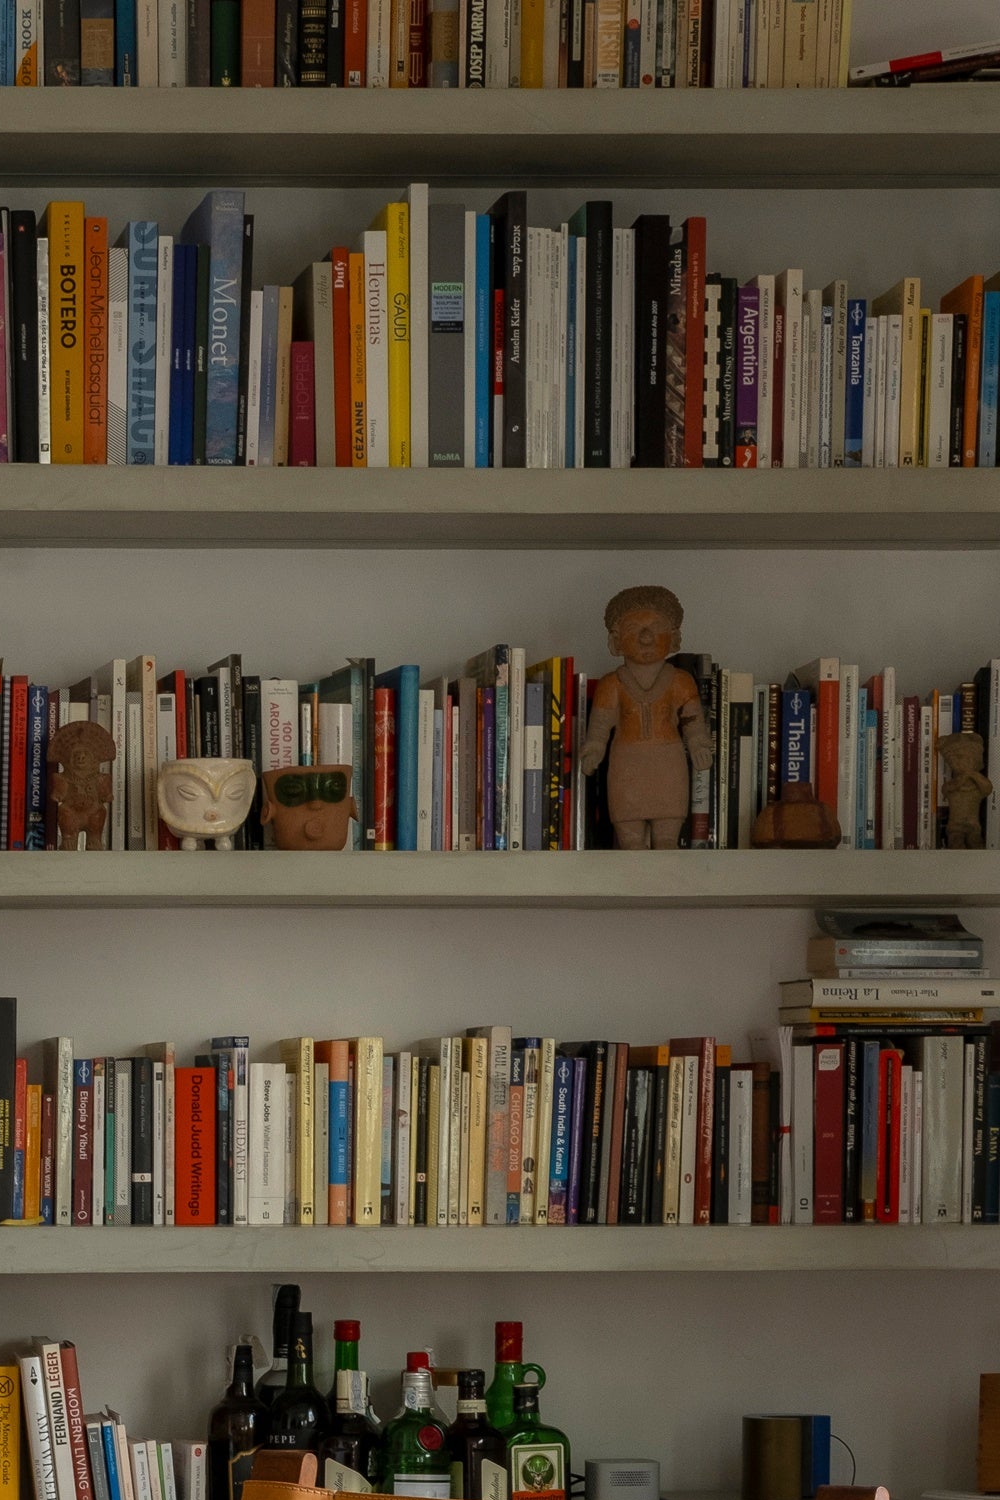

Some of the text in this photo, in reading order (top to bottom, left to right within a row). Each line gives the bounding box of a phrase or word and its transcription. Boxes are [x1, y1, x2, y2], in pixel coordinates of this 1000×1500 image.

[334, 260, 346, 289] Dufy
[368, 262, 386, 345] Heroínas
[60, 264, 76, 349] BOTERO
[86, 246, 105, 426] Jean-Michel Basquiat
[210, 277, 237, 366] Monet
[393, 292, 409, 342] GAUDÍ
[511, 298, 521, 363] Anselm Kiefer
[739, 307, 758, 386] Argentina
[851, 333, 862, 385] Tanzania
[352, 401, 364, 460] CÉZANNE
[32, 716, 42, 741] HONG
[32, 743, 42, 766] KONG
[31, 777, 41, 807] MACAU
[557, 1115, 566, 1136] India
[558, 1087, 567, 1113] South
[188, 1075, 203, 1216] Donald Judd Writings
[235, 1119, 247, 1183] BUDAPEST
[261, 1079, 272, 1186] Steve Jobs Walter Isaacson
[554, 1147, 564, 1174] Kerala
[35, 1411, 50, 1444] AMY
[44, 1351, 68, 1445] FERNAND LÉGER
[2, 1403, 12, 1485] The Monocle Guide
[66, 1387, 90, 1491] MODERN LIVING
[268, 1434, 296, 1444] PEPE
